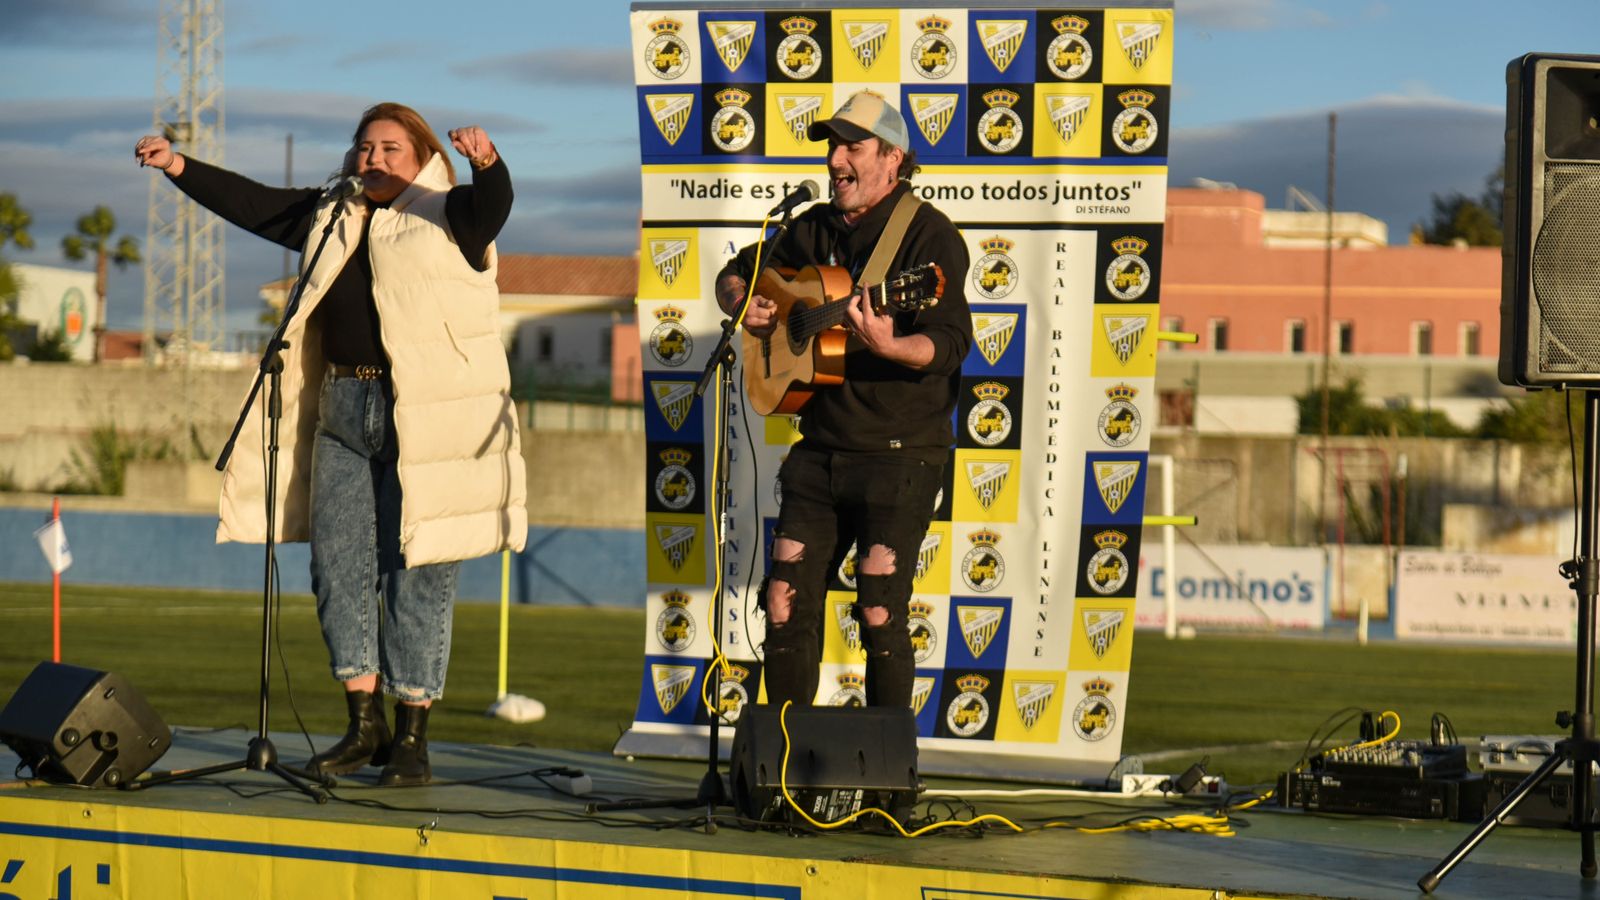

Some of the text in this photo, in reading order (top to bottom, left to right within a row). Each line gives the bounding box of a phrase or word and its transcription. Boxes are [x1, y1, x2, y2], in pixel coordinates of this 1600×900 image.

[671, 179, 743, 199] "Nadie
[750, 185, 775, 199] es
[981, 181, 1048, 200] todos
[1052, 180, 1142, 205] juntos"
[1076, 206, 1086, 214] DI
[1054, 242, 1066, 306] REAL
[1034, 541, 1051, 657] LINENSE
[1151, 567, 1313, 603] Domino's
